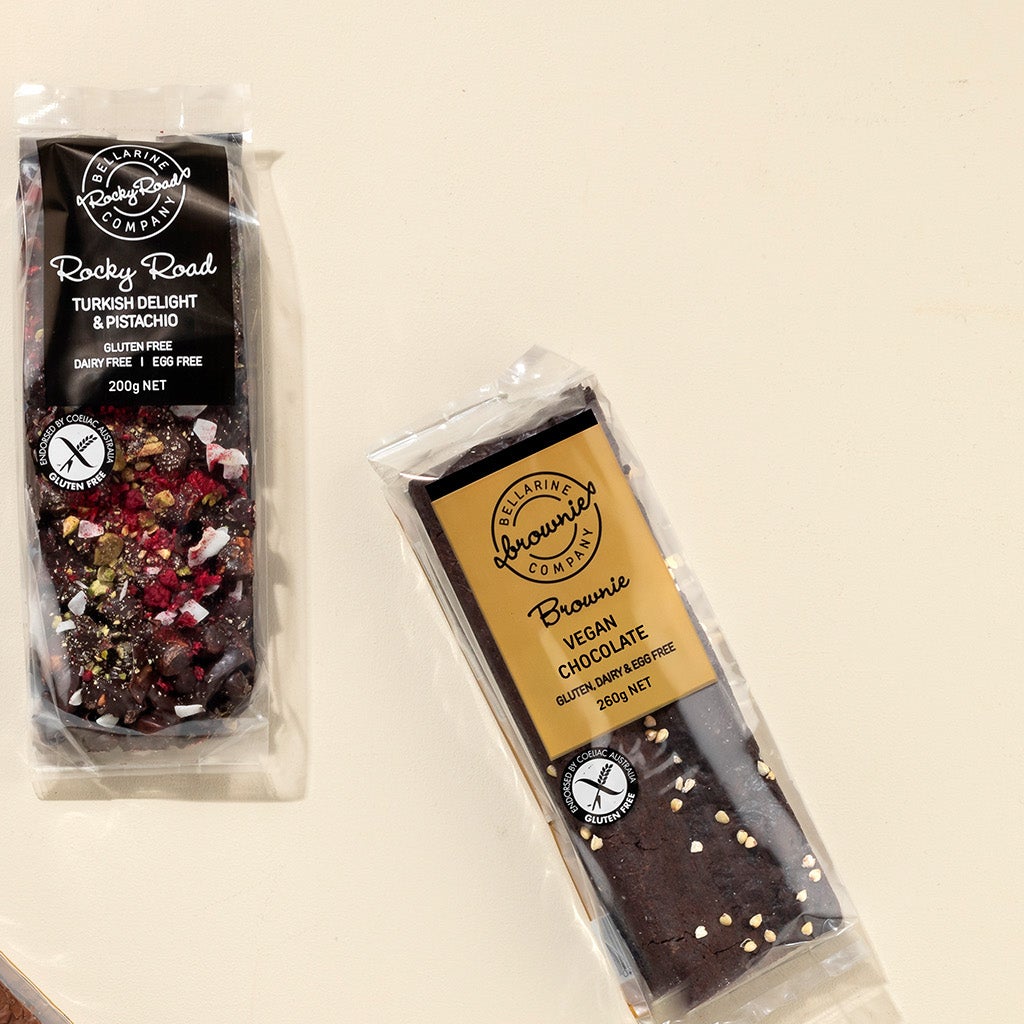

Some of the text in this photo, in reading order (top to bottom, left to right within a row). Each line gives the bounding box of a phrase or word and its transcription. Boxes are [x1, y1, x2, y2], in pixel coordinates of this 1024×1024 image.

[91, 149, 169, 183] BELLARINE
[101, 196, 176, 233] COMPANY
[50, 252, 217, 292] Rocky Road
[72, 294, 198, 312] TURKISH DELIGHT
[93, 314, 178, 329] & PISTACHIO
[74, 358, 104, 369] DAIRY
[106, 357, 132, 367] FREE
[152, 356, 174, 367] EGG
[177, 356, 202, 366] FREE
[104, 341, 172, 352] GLUTEN FREE
[108, 379, 166, 394] 200g NET
[39, 414, 114, 465] ENDORSED BY COELIAC AUSTRALIA
[49, 471, 106, 490] GLUTEN FREE
[499, 480, 571, 526] BELLARINE
[500, 495, 592, 563] brownie
[529, 528, 593, 575] COMPANY
[528, 574, 630, 628] Brownie
[563, 615, 617, 650] VEGAN
[558, 625, 648, 679] CHOCOLATE
[556, 641, 676, 706] GLUTEN, DAIRY & EGG FREE
[596, 677, 652, 711] 260g NET
[563, 750, 636, 813] ENDORSED BY COELIAC AUSTRALIA
[585, 793, 635, 824] GLUTEN FREE
